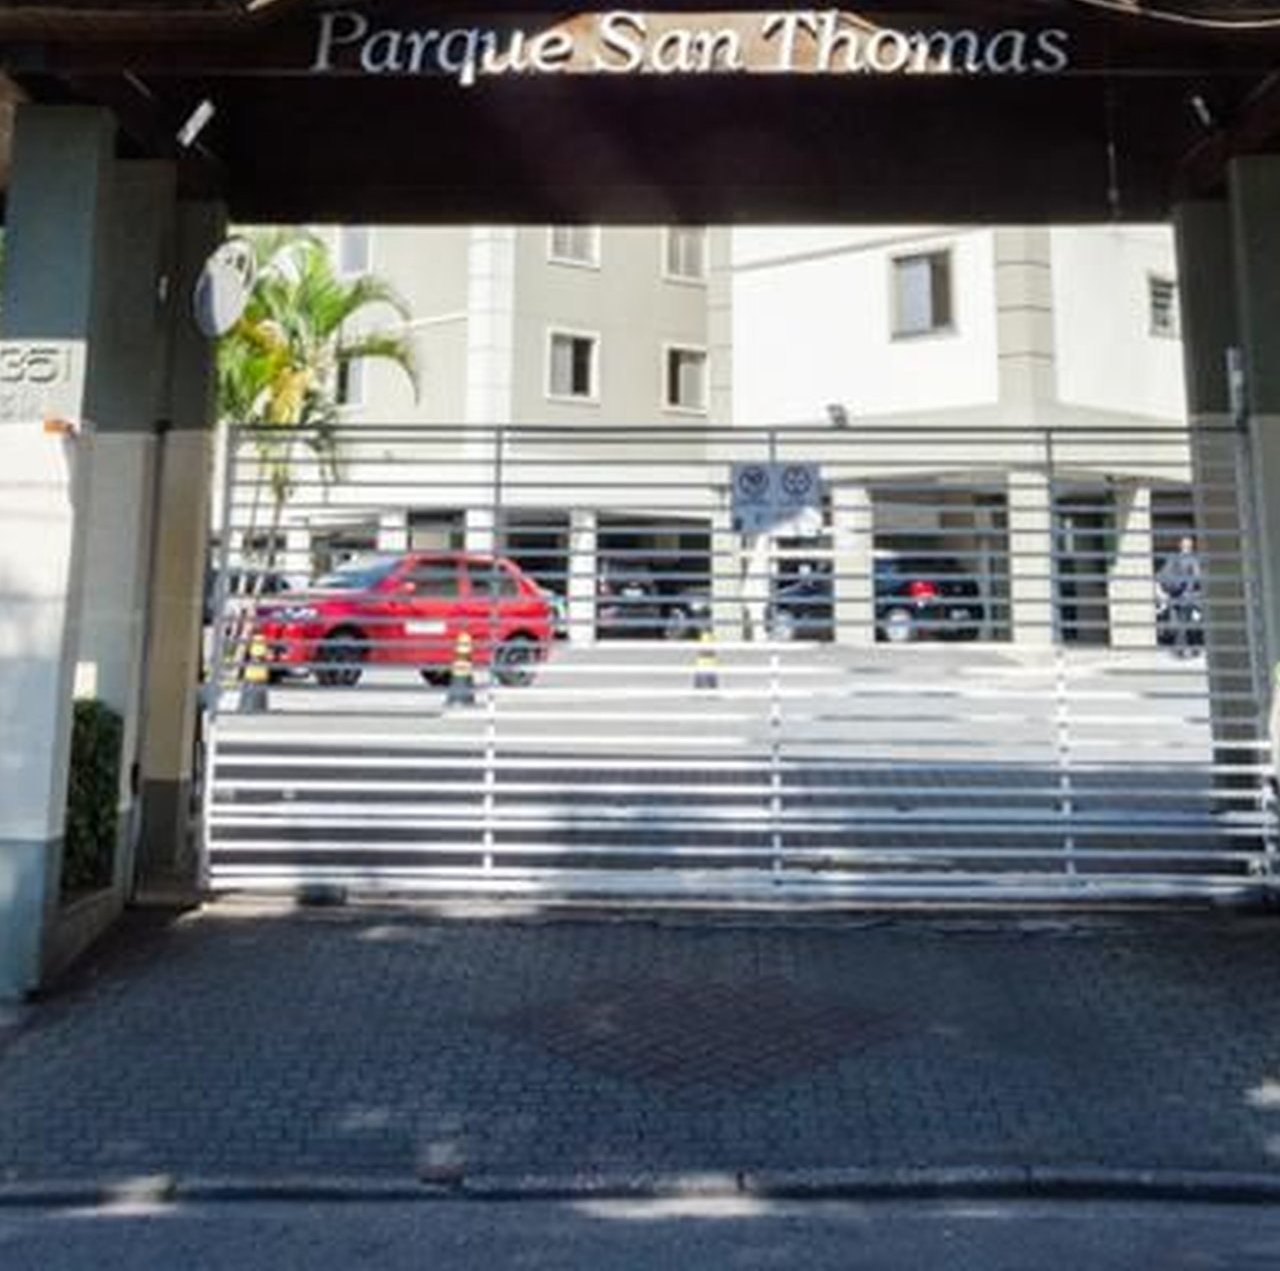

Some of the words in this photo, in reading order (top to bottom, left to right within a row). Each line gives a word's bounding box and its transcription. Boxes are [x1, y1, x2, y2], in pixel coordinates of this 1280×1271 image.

[310, 11, 573, 86] Parque
[594, 12, 744, 73] San
[762, 10, 1068, 73] Thomas
